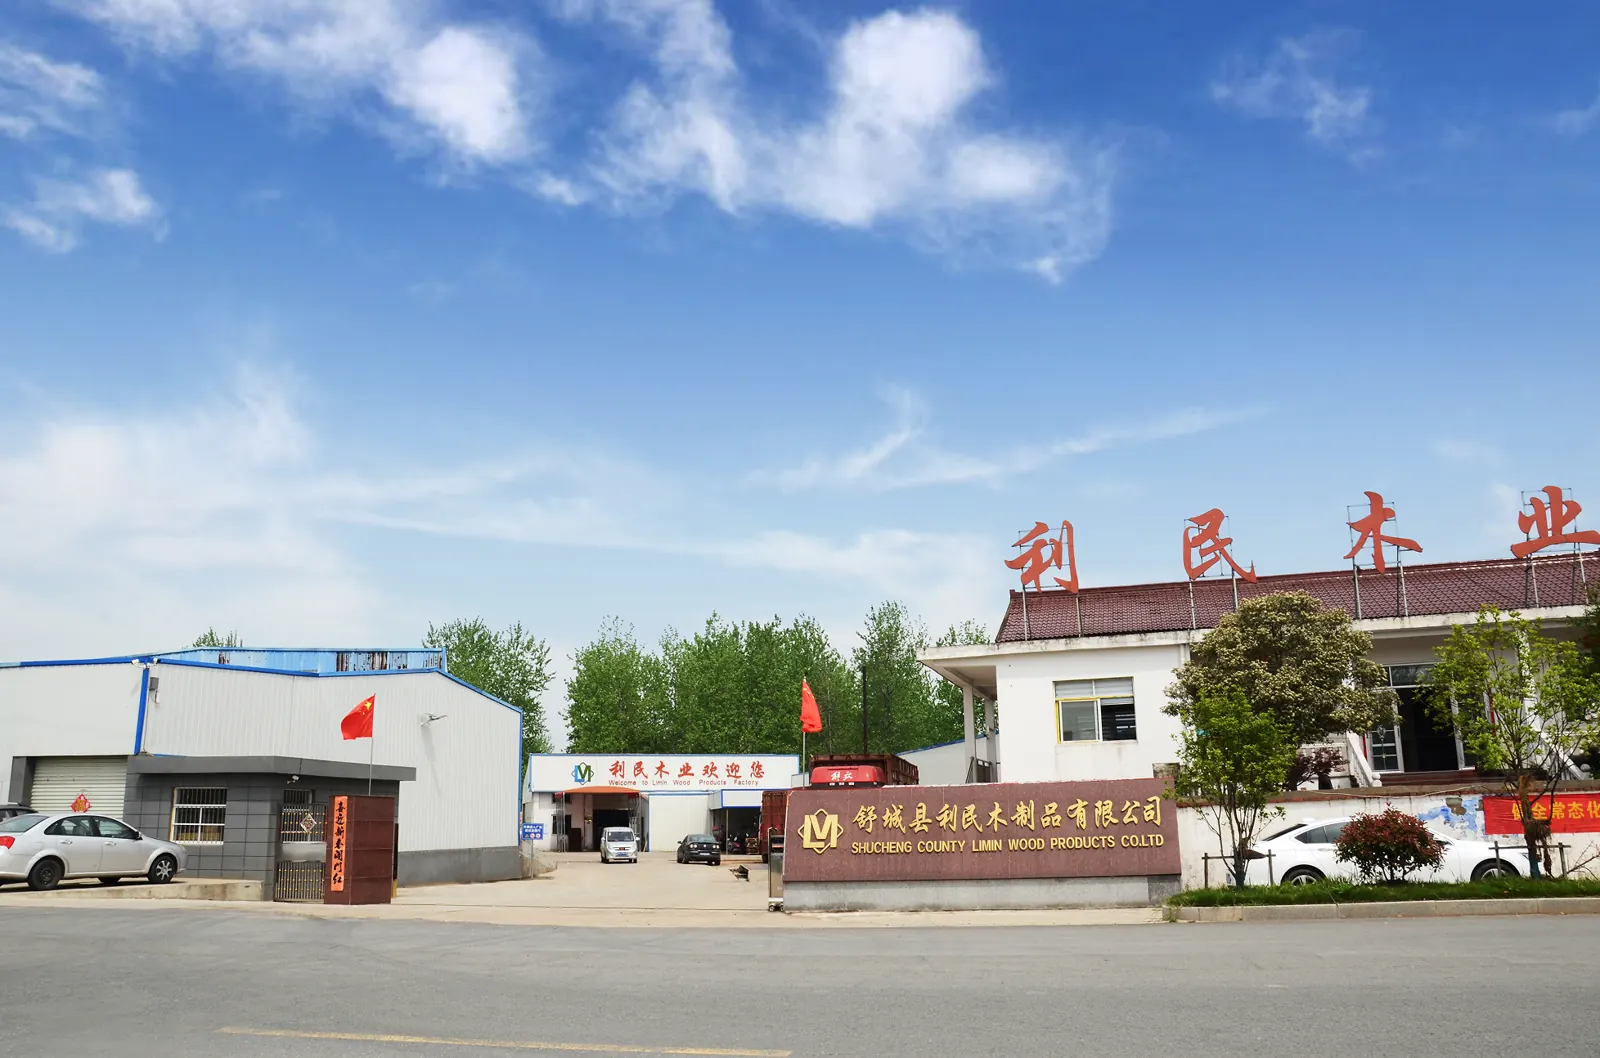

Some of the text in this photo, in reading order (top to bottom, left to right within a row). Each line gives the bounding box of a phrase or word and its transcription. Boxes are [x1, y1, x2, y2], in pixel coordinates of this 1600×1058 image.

[1004, 485, 1600, 594] 利民木业
[608, 760, 765, 779] 利民木业欢迎您
[733, 779, 759, 787] Factory
[852, 795, 1163, 834] 舒城县利民木制品有限公司
[851, 840, 913, 855] SHUCHENG
[917, 839, 966, 853] COUNTY
[972, 838, 1003, 852] LIMIN
[1008, 837, 1045, 851] WOOD
[1050, 835, 1116, 851] PRODUCTS
